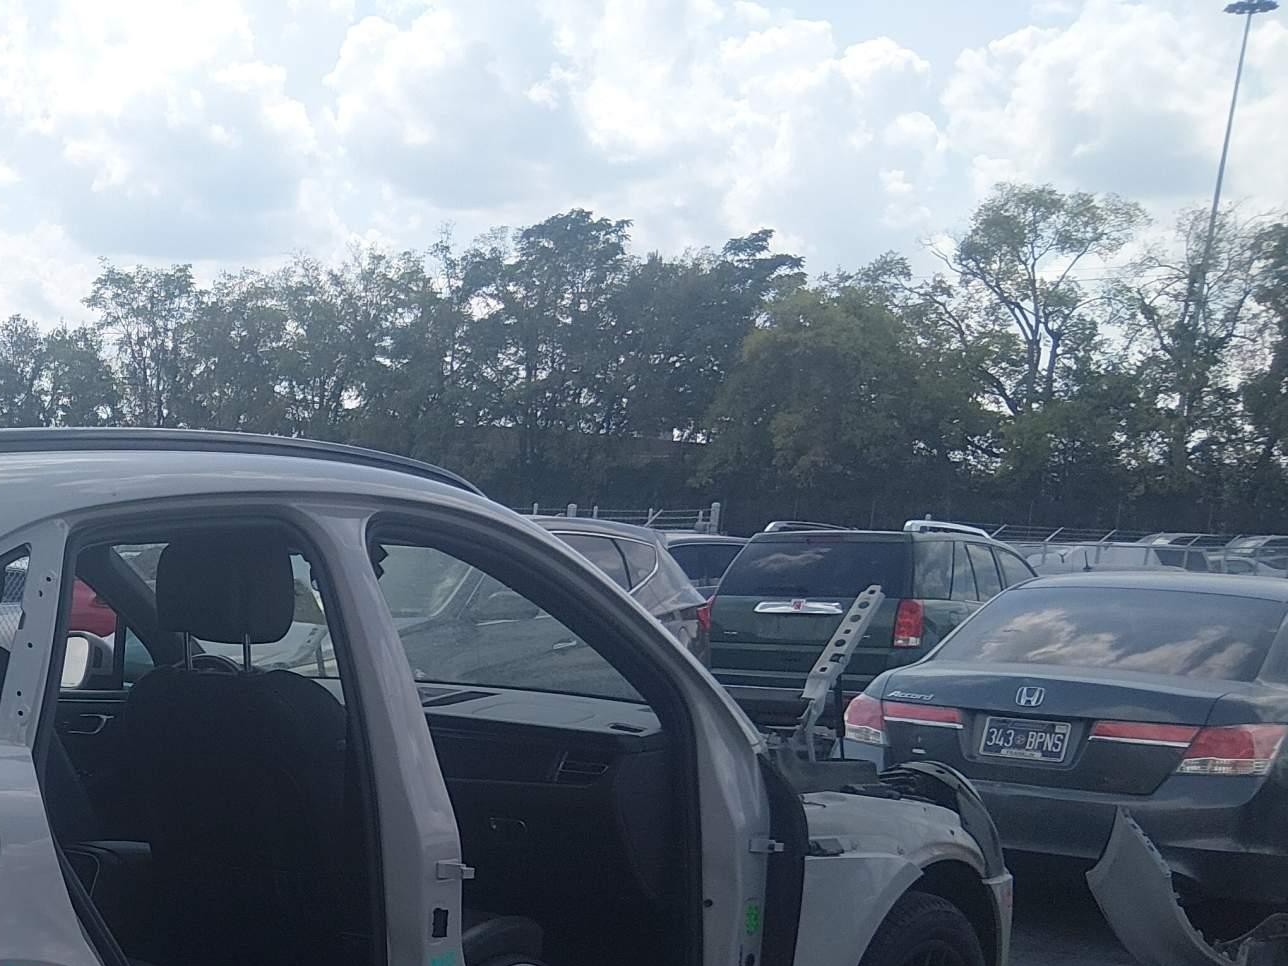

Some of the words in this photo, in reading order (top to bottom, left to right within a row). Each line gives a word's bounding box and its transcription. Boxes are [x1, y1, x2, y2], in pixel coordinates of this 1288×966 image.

[887, 690, 935, 701] Accord
[986, 728, 1015, 747] 343
[1025, 731, 1064, 752] BPNS
